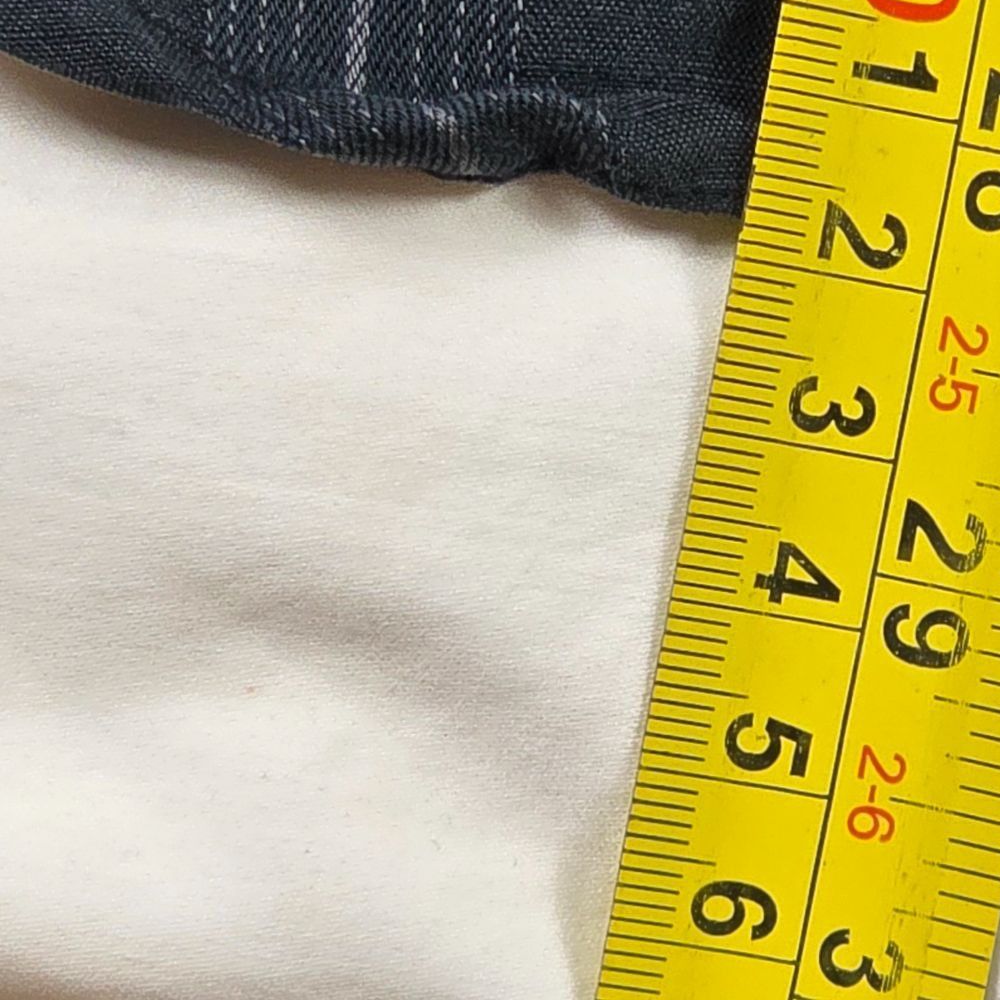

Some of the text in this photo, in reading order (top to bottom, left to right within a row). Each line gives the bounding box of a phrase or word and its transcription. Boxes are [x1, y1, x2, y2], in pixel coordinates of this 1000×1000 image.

[852, 50, 938, 92] 1
[818, 200, 907, 270] 2
[929, 317, 988, 413] 2-5
[789, 376, 876, 437] 3
[755, 541, 841, 604] 4
[882, 498, 988, 669] 29
[724, 713, 812, 777] 5
[847, 745, 906, 841] 2-6
[690, 880, 777, 940] 6
